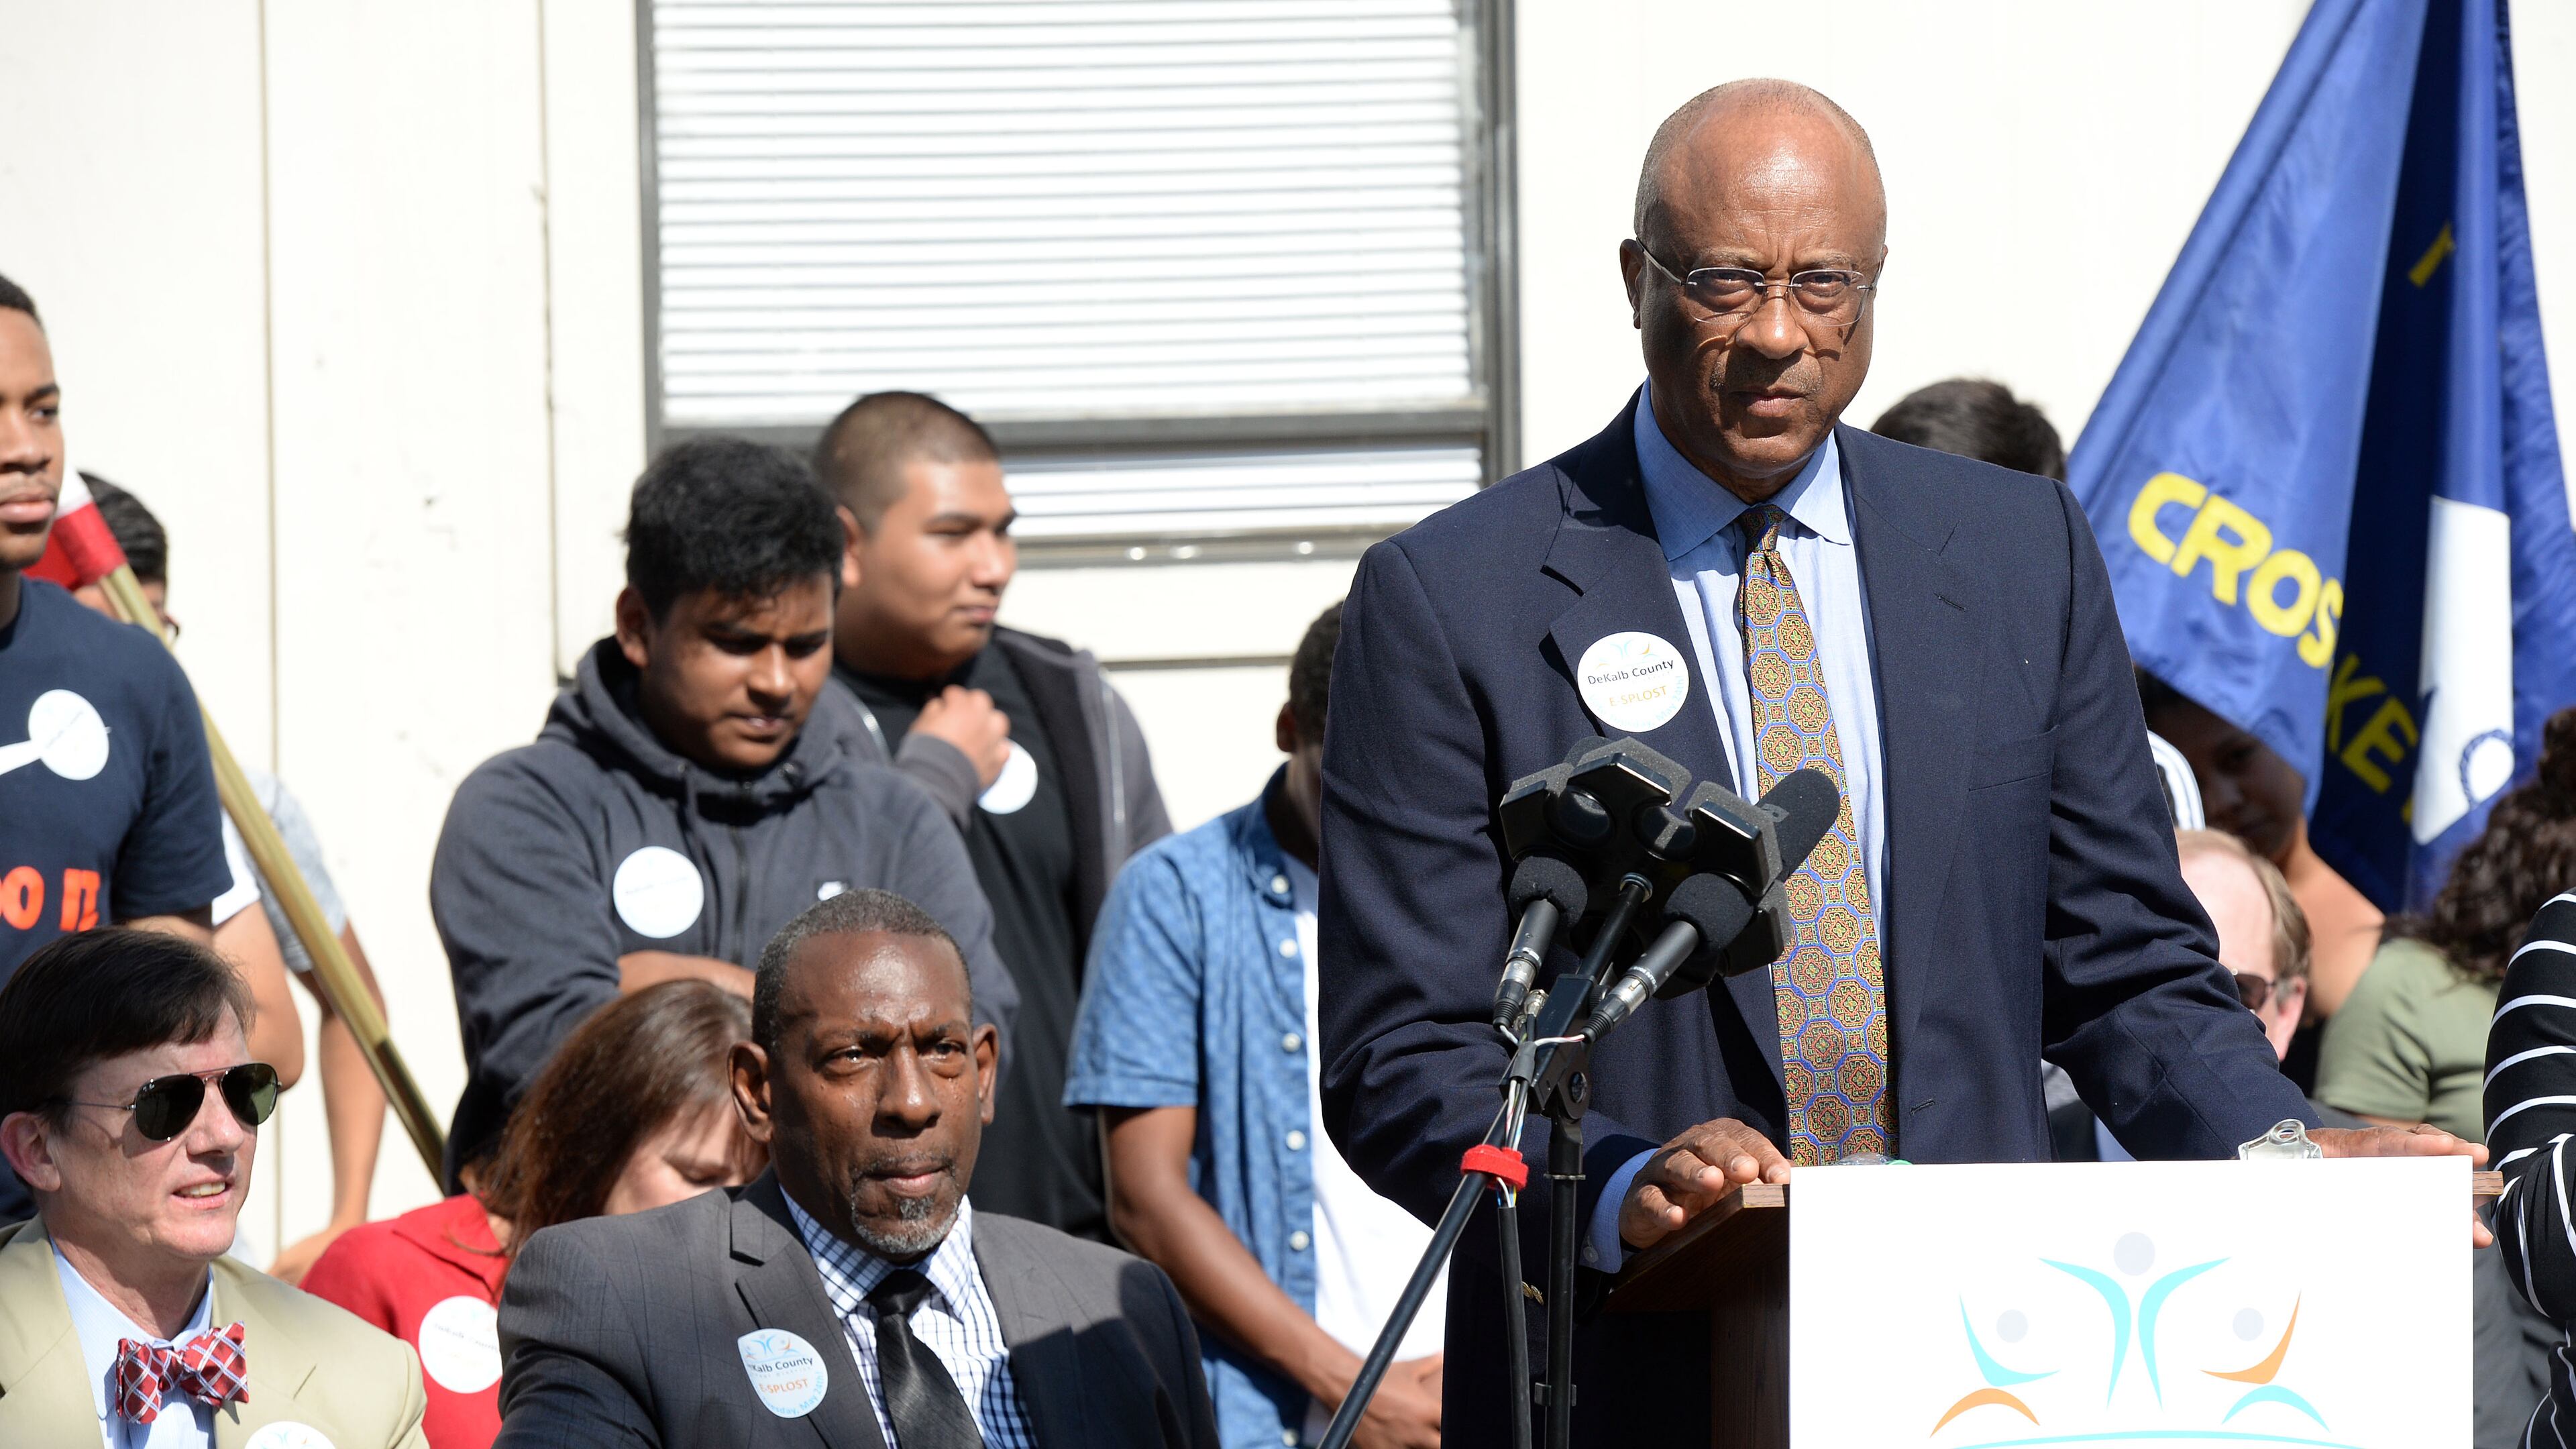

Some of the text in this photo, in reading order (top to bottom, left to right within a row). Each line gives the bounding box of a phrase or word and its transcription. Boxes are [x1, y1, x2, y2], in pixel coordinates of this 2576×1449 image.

[1587, 670, 1629, 685] DeKalb
[1631, 659, 1674, 678] County
[1609, 686, 1667, 706] E-SPLOST
[2327, 653, 2419, 825] KE
[0, 865, 45, 930] O
[775, 1357, 814, 1371] County
